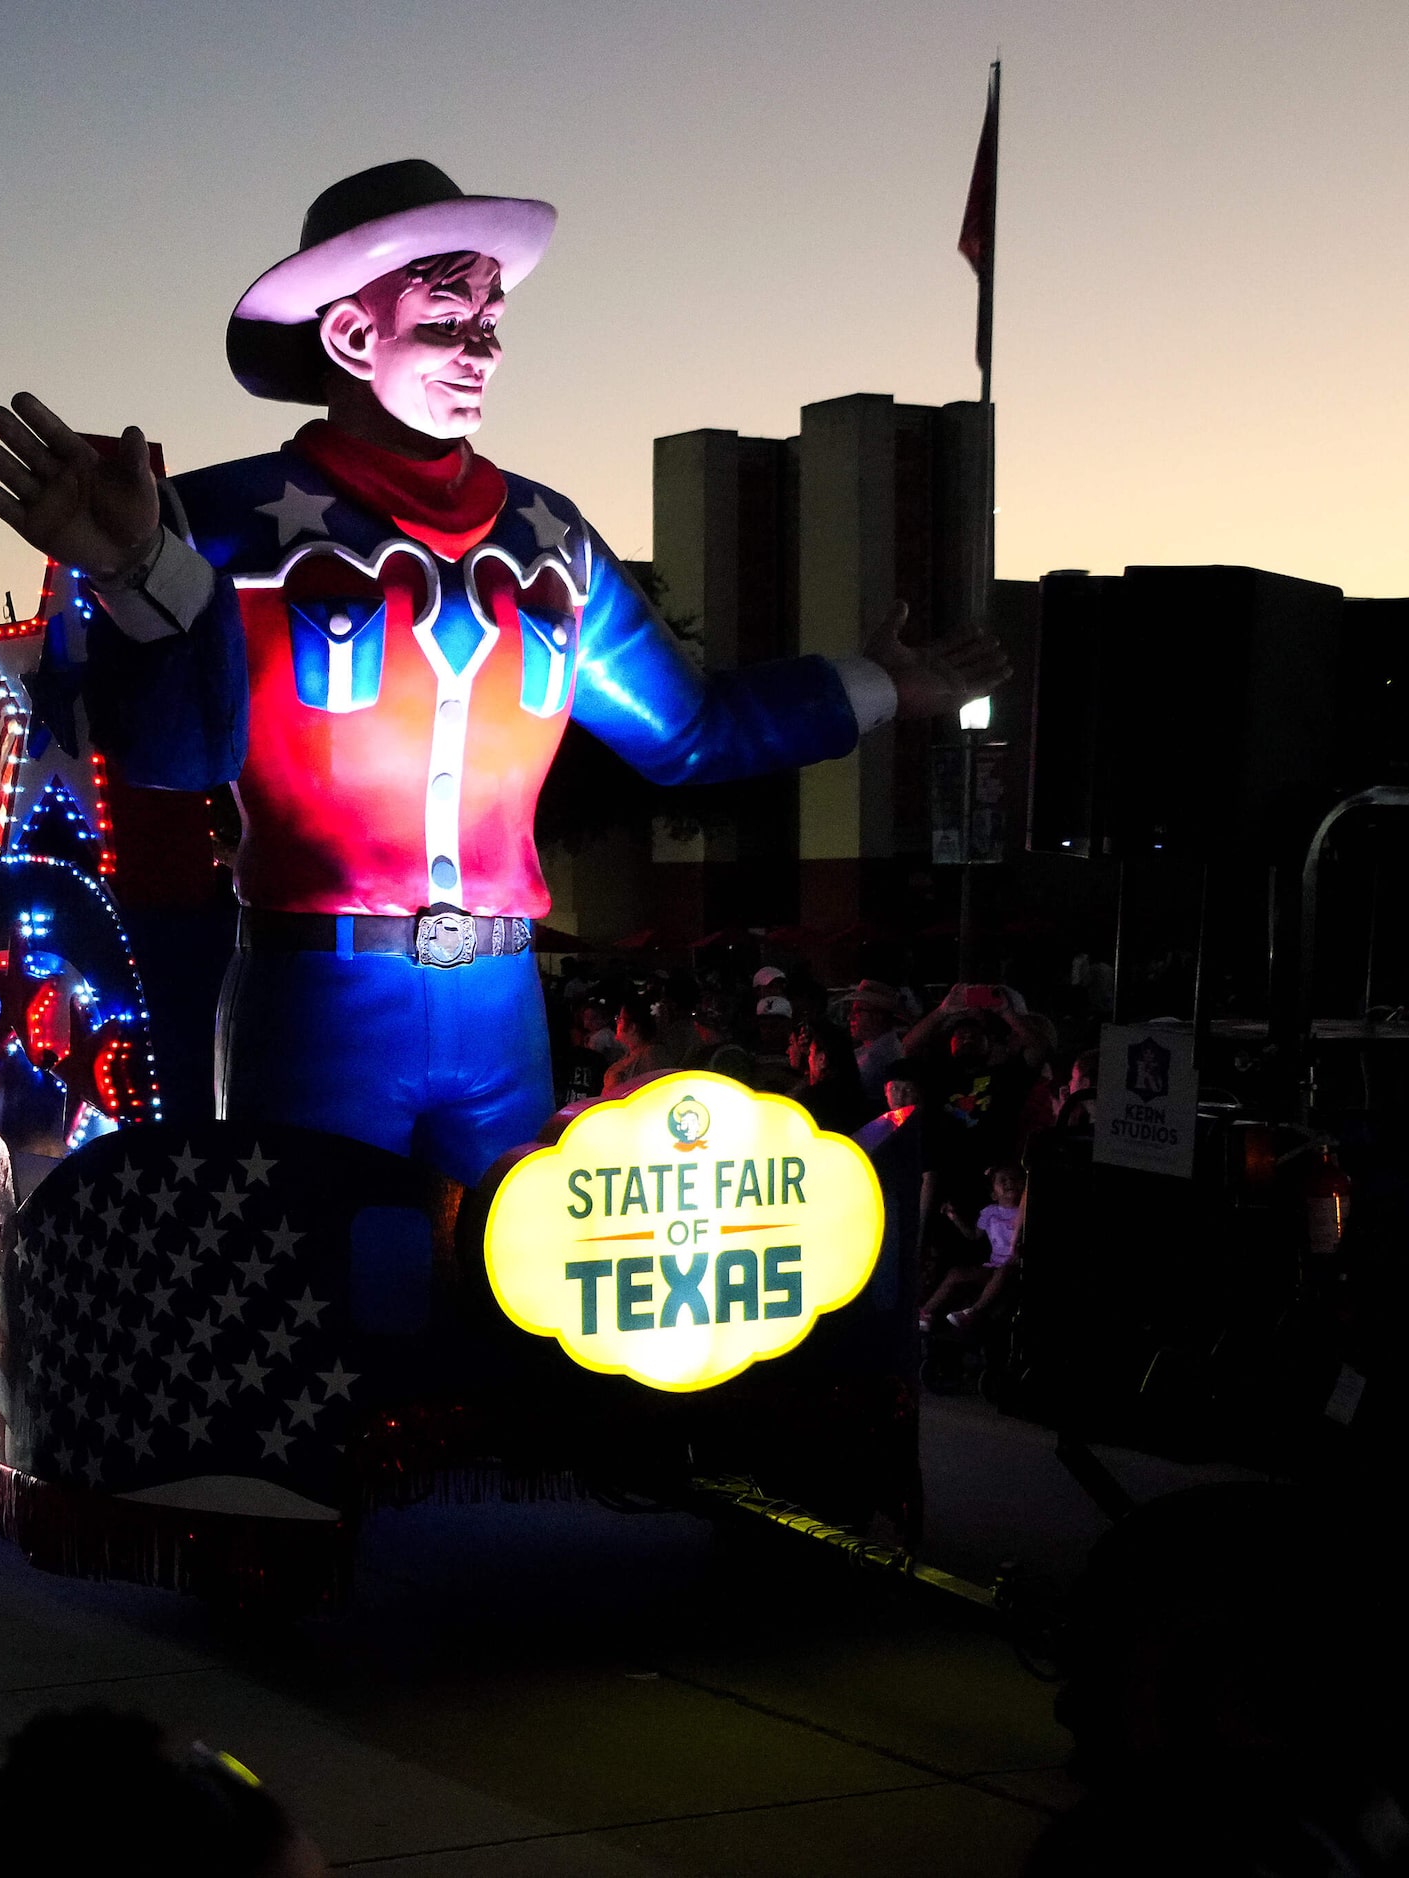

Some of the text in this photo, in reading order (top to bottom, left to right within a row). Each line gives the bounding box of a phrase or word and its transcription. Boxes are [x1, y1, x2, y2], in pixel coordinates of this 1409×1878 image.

[1125, 1103, 1166, 1124] KERN
[1111, 1119, 1178, 1145] STUDIOS
[566, 1156, 807, 1220] STATE FAIR
[667, 1218, 710, 1246] OF
[565, 1244, 803, 1336] TEXAS
